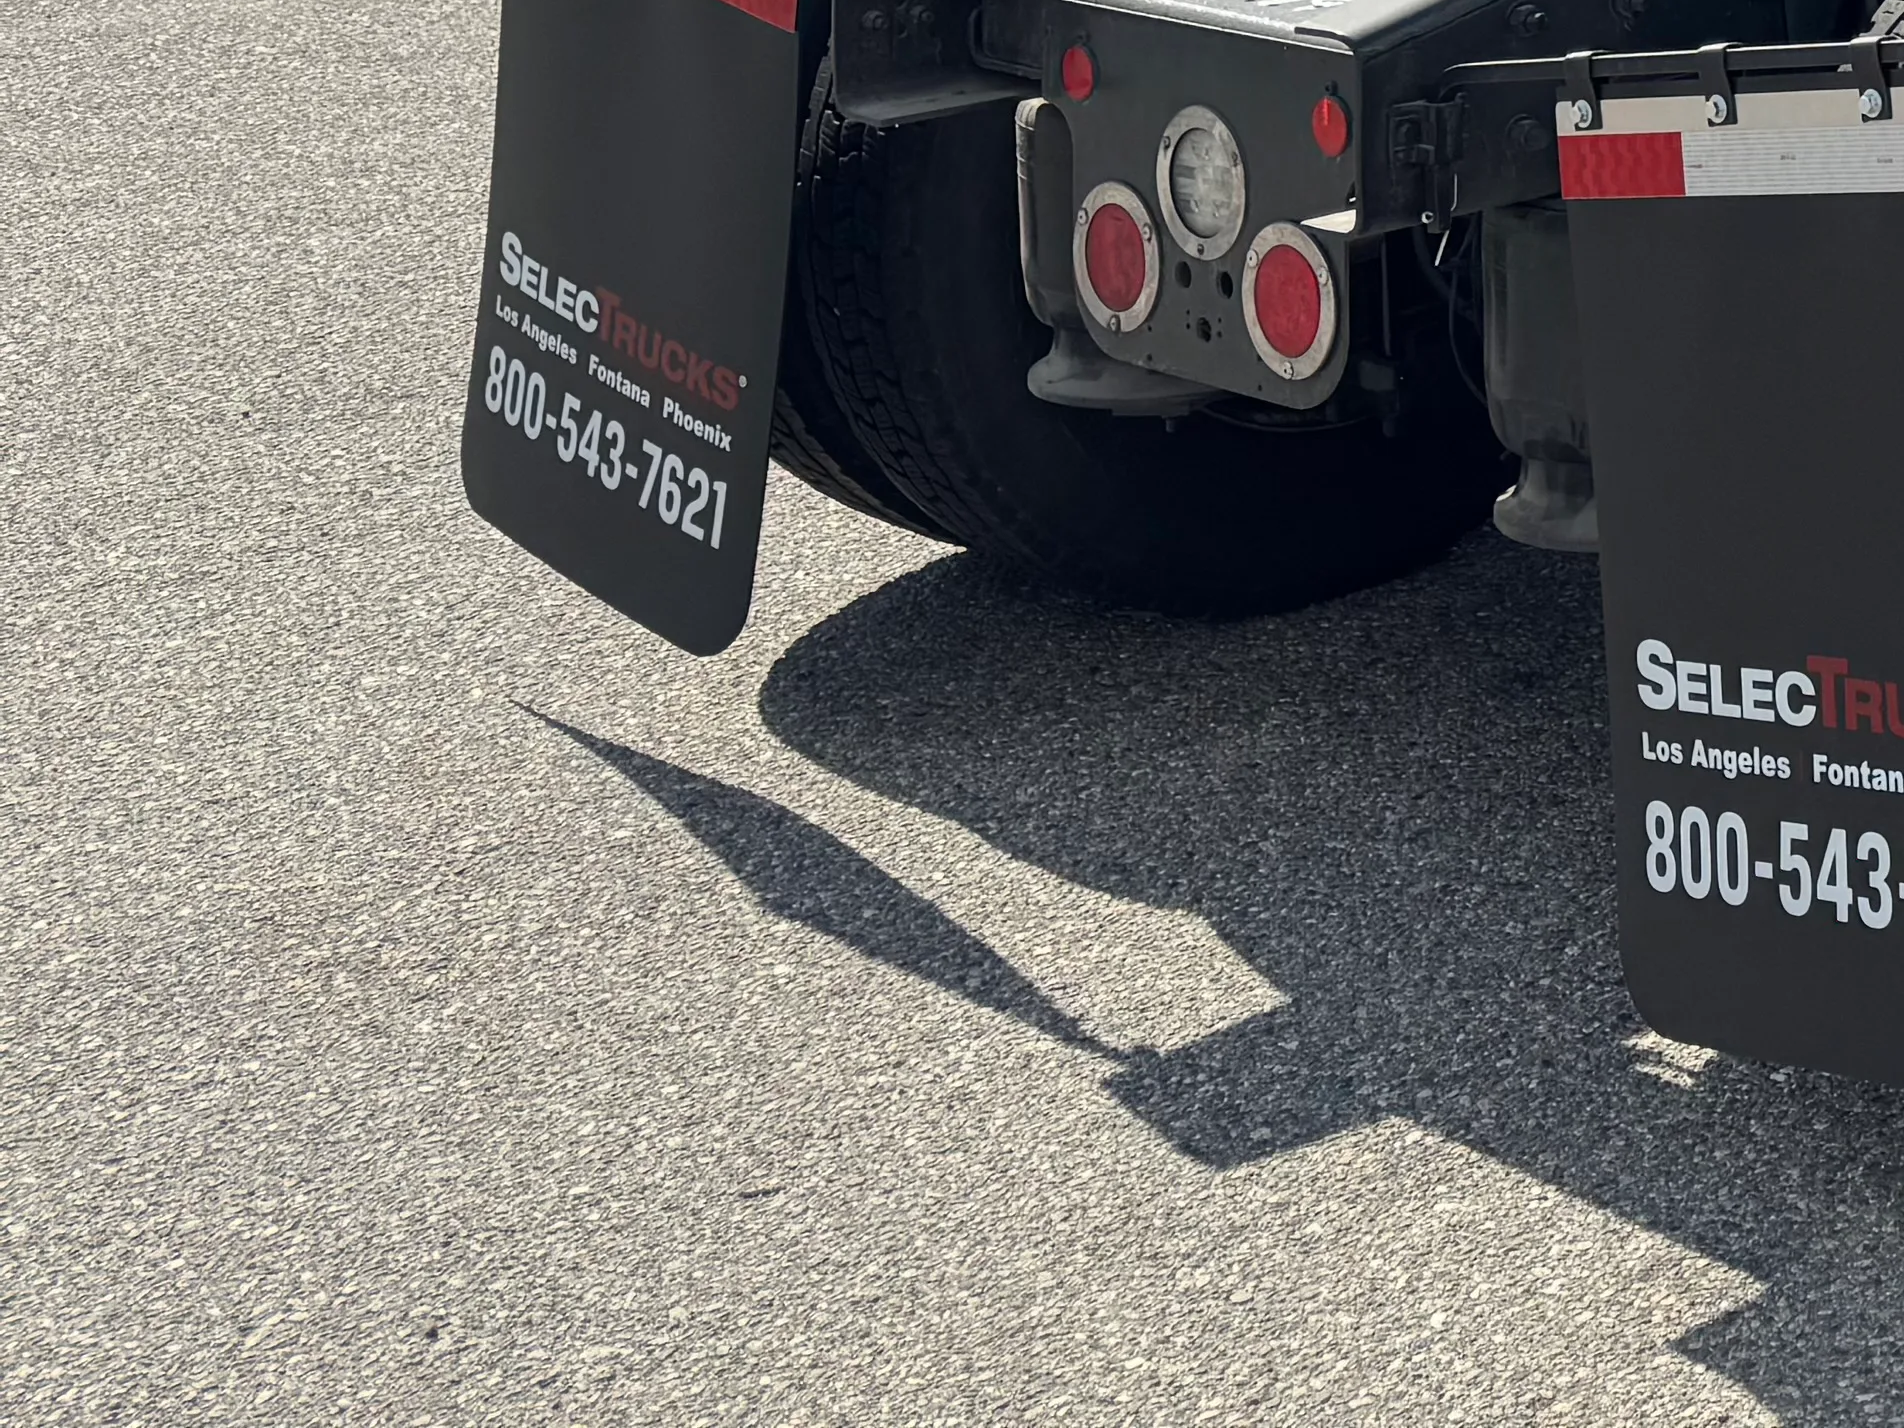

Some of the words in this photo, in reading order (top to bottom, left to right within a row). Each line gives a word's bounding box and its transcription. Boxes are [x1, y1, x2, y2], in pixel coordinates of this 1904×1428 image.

[485, 345, 728, 550] 800-543-7621
[496, 294, 519, 327] Los
[521, 314, 578, 365] Angeles
[588, 354, 650, 408] Fontana
[663, 397, 732, 452] Phoenix
[1641, 731, 1684, 765] Los
[1690, 739, 1792, 780] Angeles
